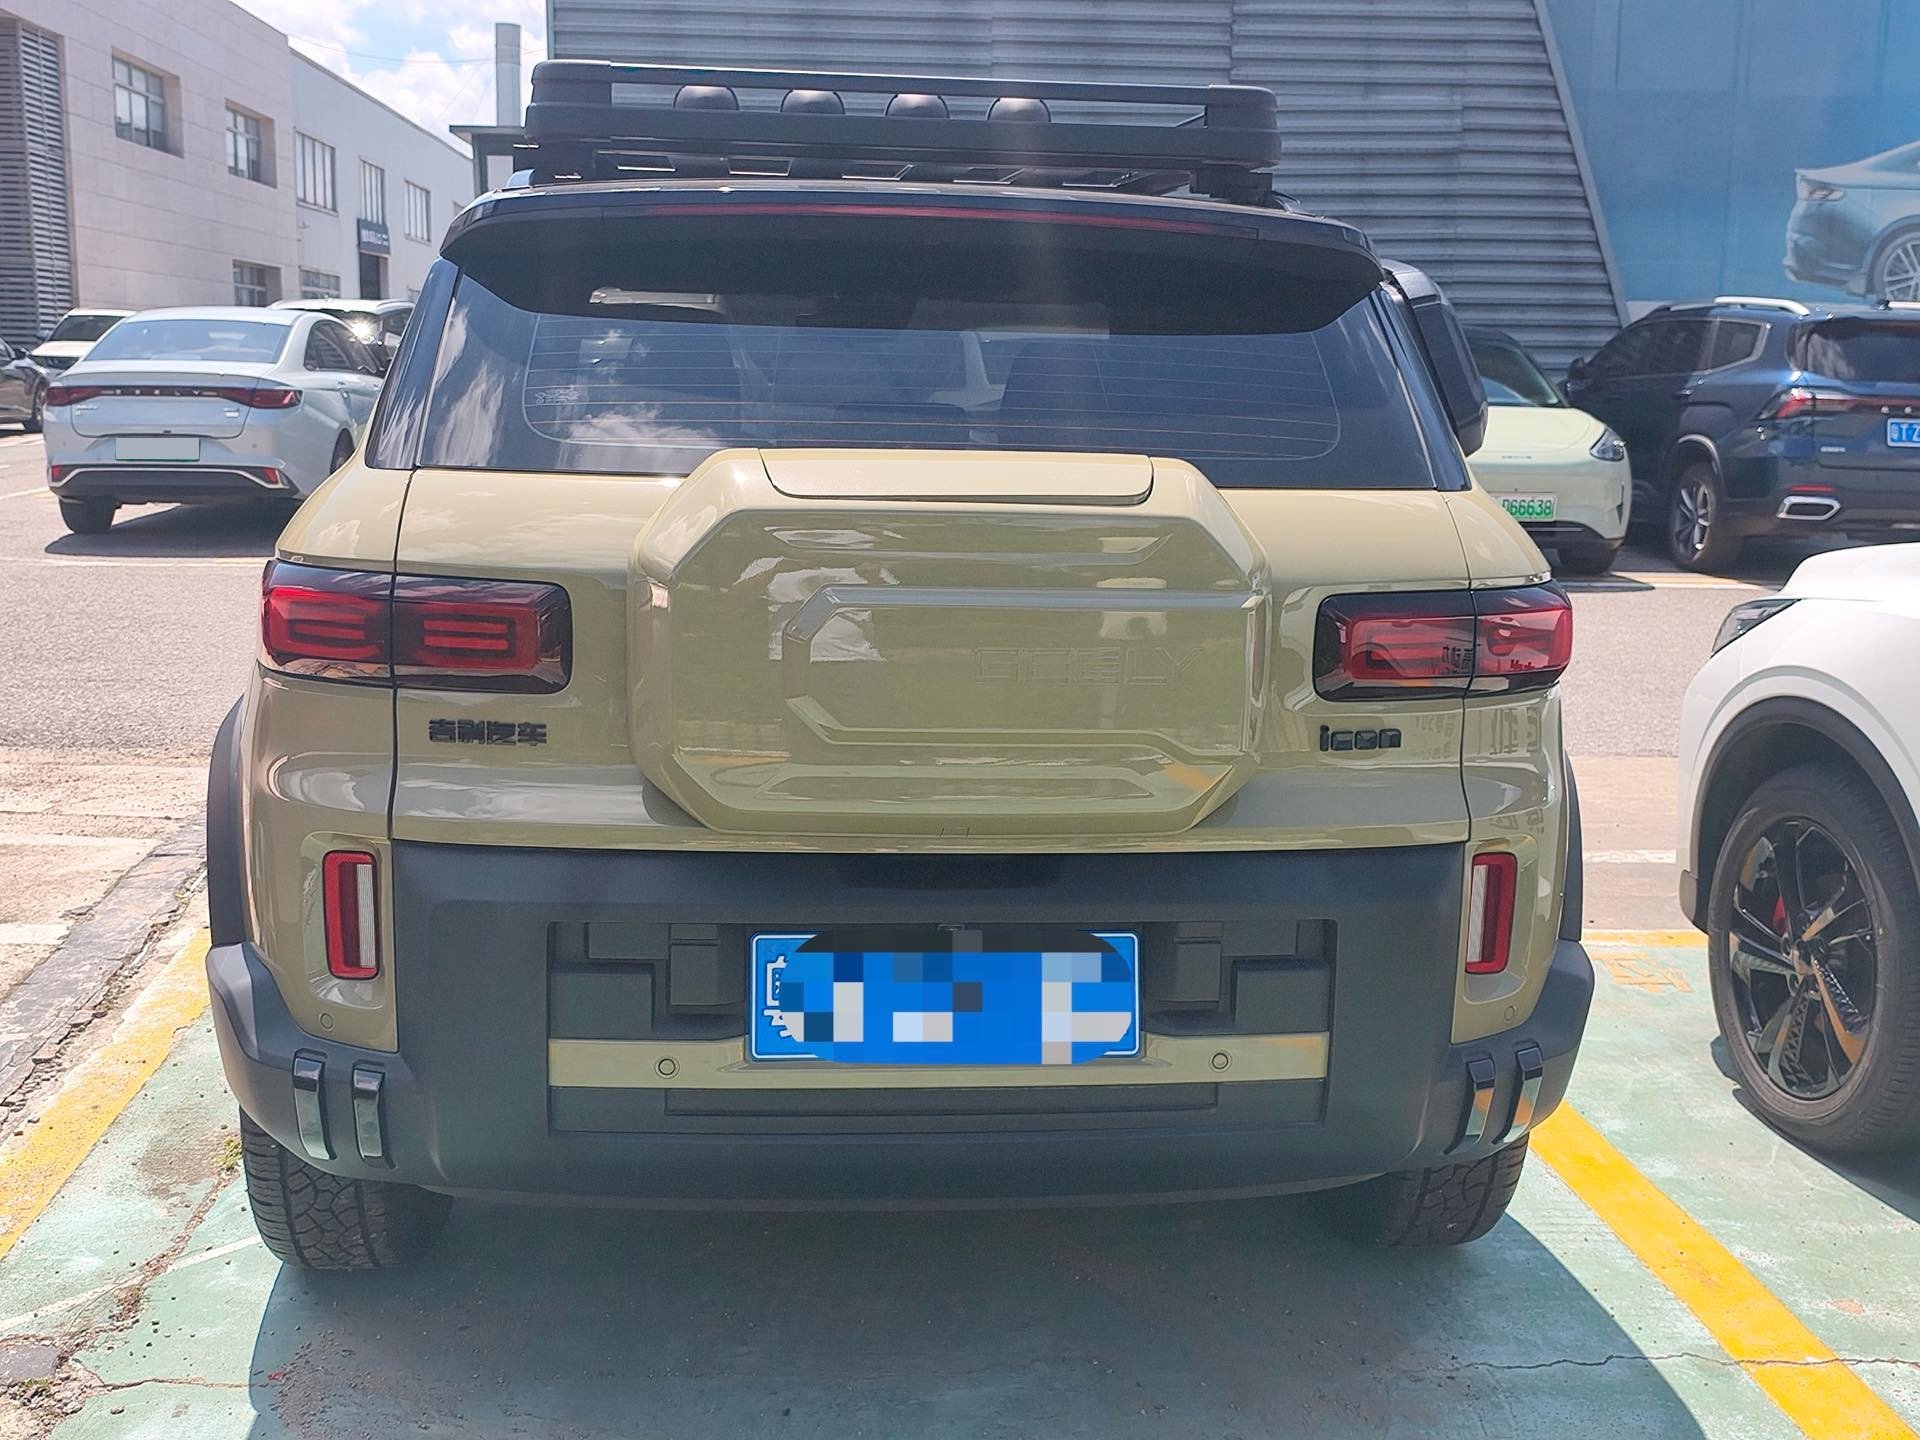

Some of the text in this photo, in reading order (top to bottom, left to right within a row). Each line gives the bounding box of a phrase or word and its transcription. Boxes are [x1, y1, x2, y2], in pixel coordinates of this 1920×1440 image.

[428, 719, 547, 746] 吉利汽车
[1319, 724, 1402, 751] icon
